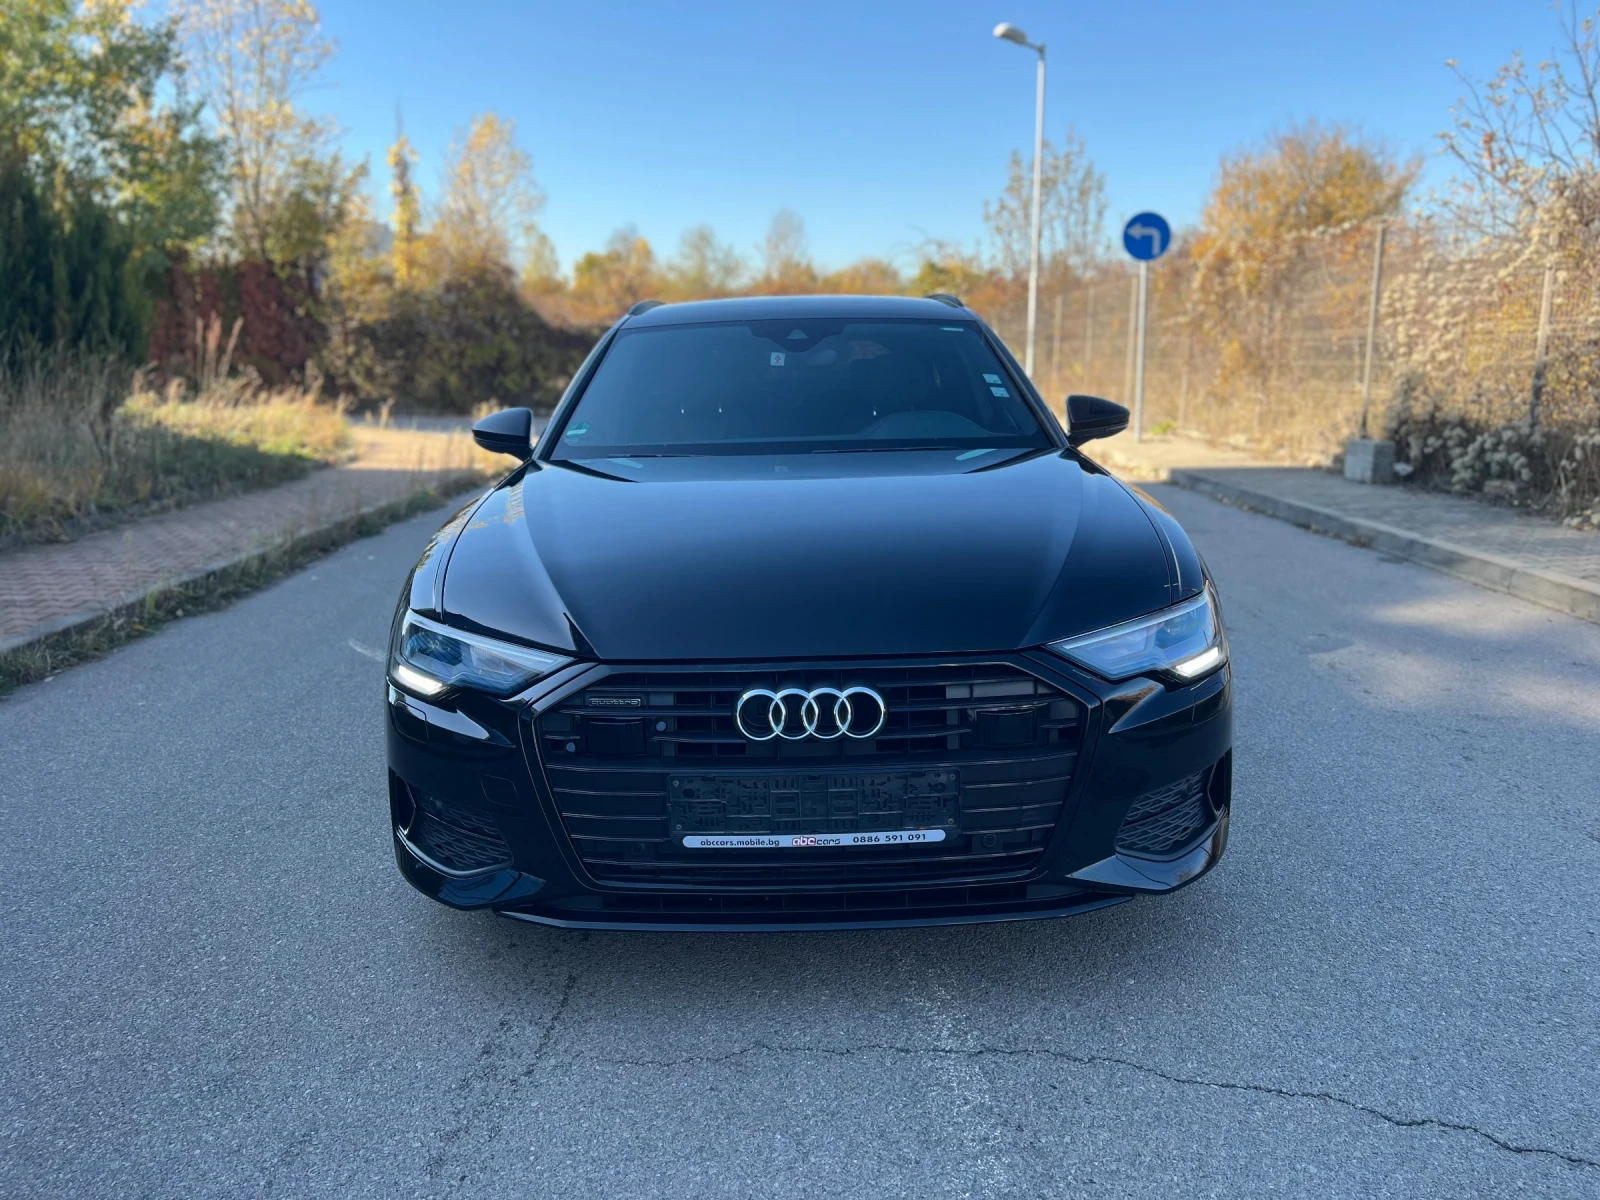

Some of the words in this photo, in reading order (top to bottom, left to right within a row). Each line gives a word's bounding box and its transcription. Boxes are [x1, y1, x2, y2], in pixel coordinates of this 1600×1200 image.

[700, 839, 780, 847] abccars.mobile.bg
[885, 834, 903, 842] 591
[907, 833, 926, 841] 091
